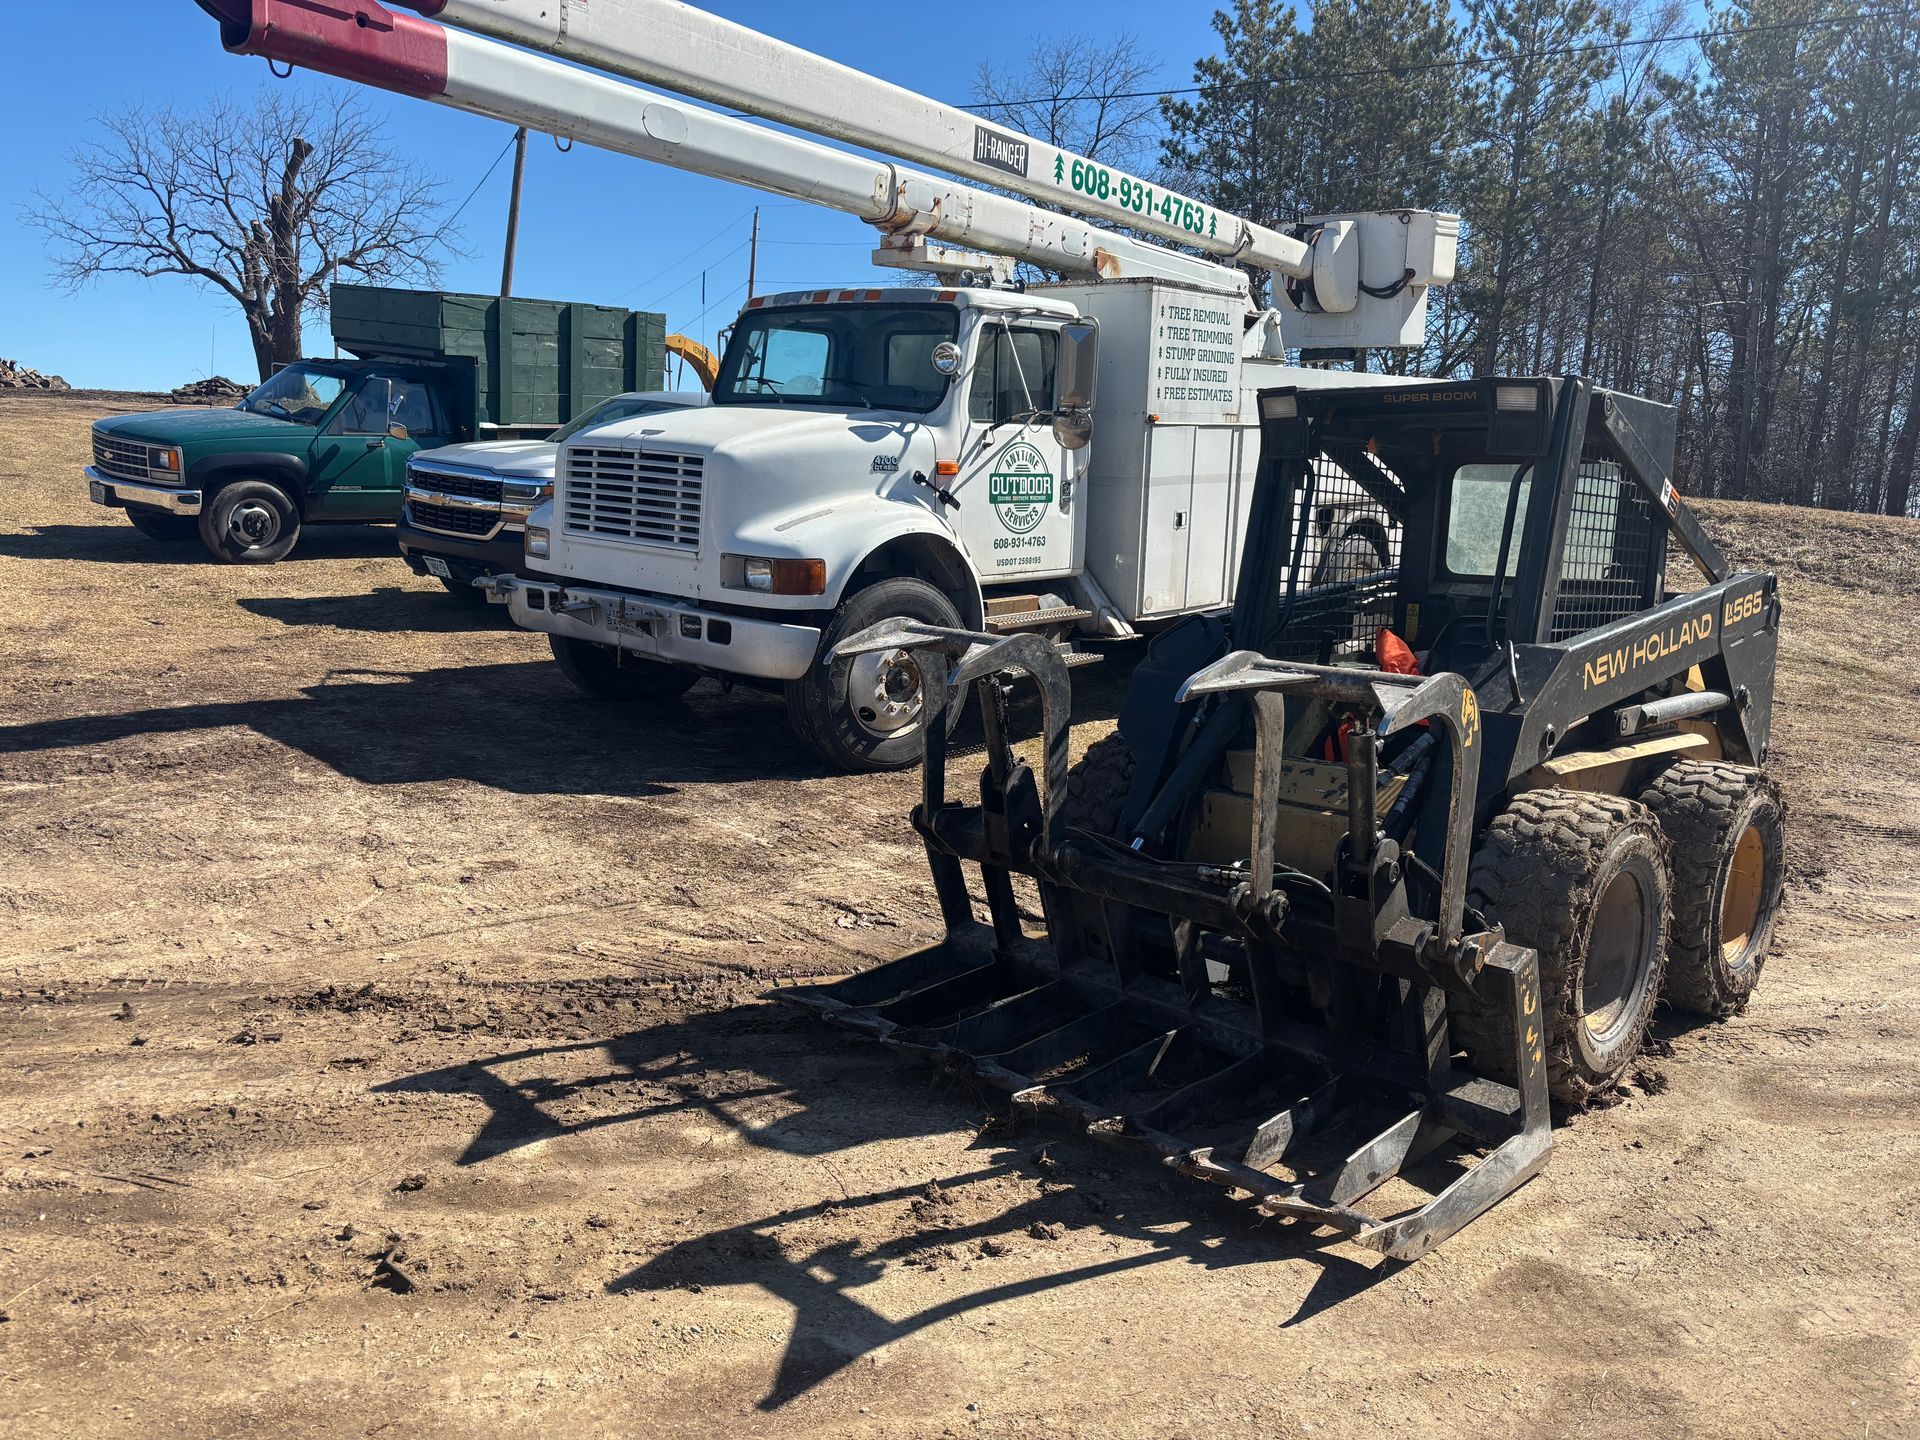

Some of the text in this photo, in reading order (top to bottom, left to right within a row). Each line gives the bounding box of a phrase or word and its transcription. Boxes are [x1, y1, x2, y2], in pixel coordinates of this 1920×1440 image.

[977, 129, 1026, 174] HI-RANGER
[1071, 159, 1205, 235] 608-931-4763
[1168, 305, 1231, 326] TREE REMOVAL
[1167, 326, 1233, 345] TREE TRIMMING
[1165, 346, 1235, 365] STUMP GRINDING
[1164, 366, 1228, 383] FULLY INSURED
[1164, 386, 1233, 402] FREE ESTIMATES
[1383, 391, 1477, 404] SUPER BOOM
[874, 455, 898, 465] 4700
[1005, 450, 1040, 470] ANYTIME
[991, 476, 1051, 495] OUTDOOR
[1004, 506, 1039, 526] SERVICES
[993, 536, 1046, 549] 608-931-4763
[996, 557, 1017, 567] USDOT
[1583, 613, 1712, 690] NEW HOLLAND
